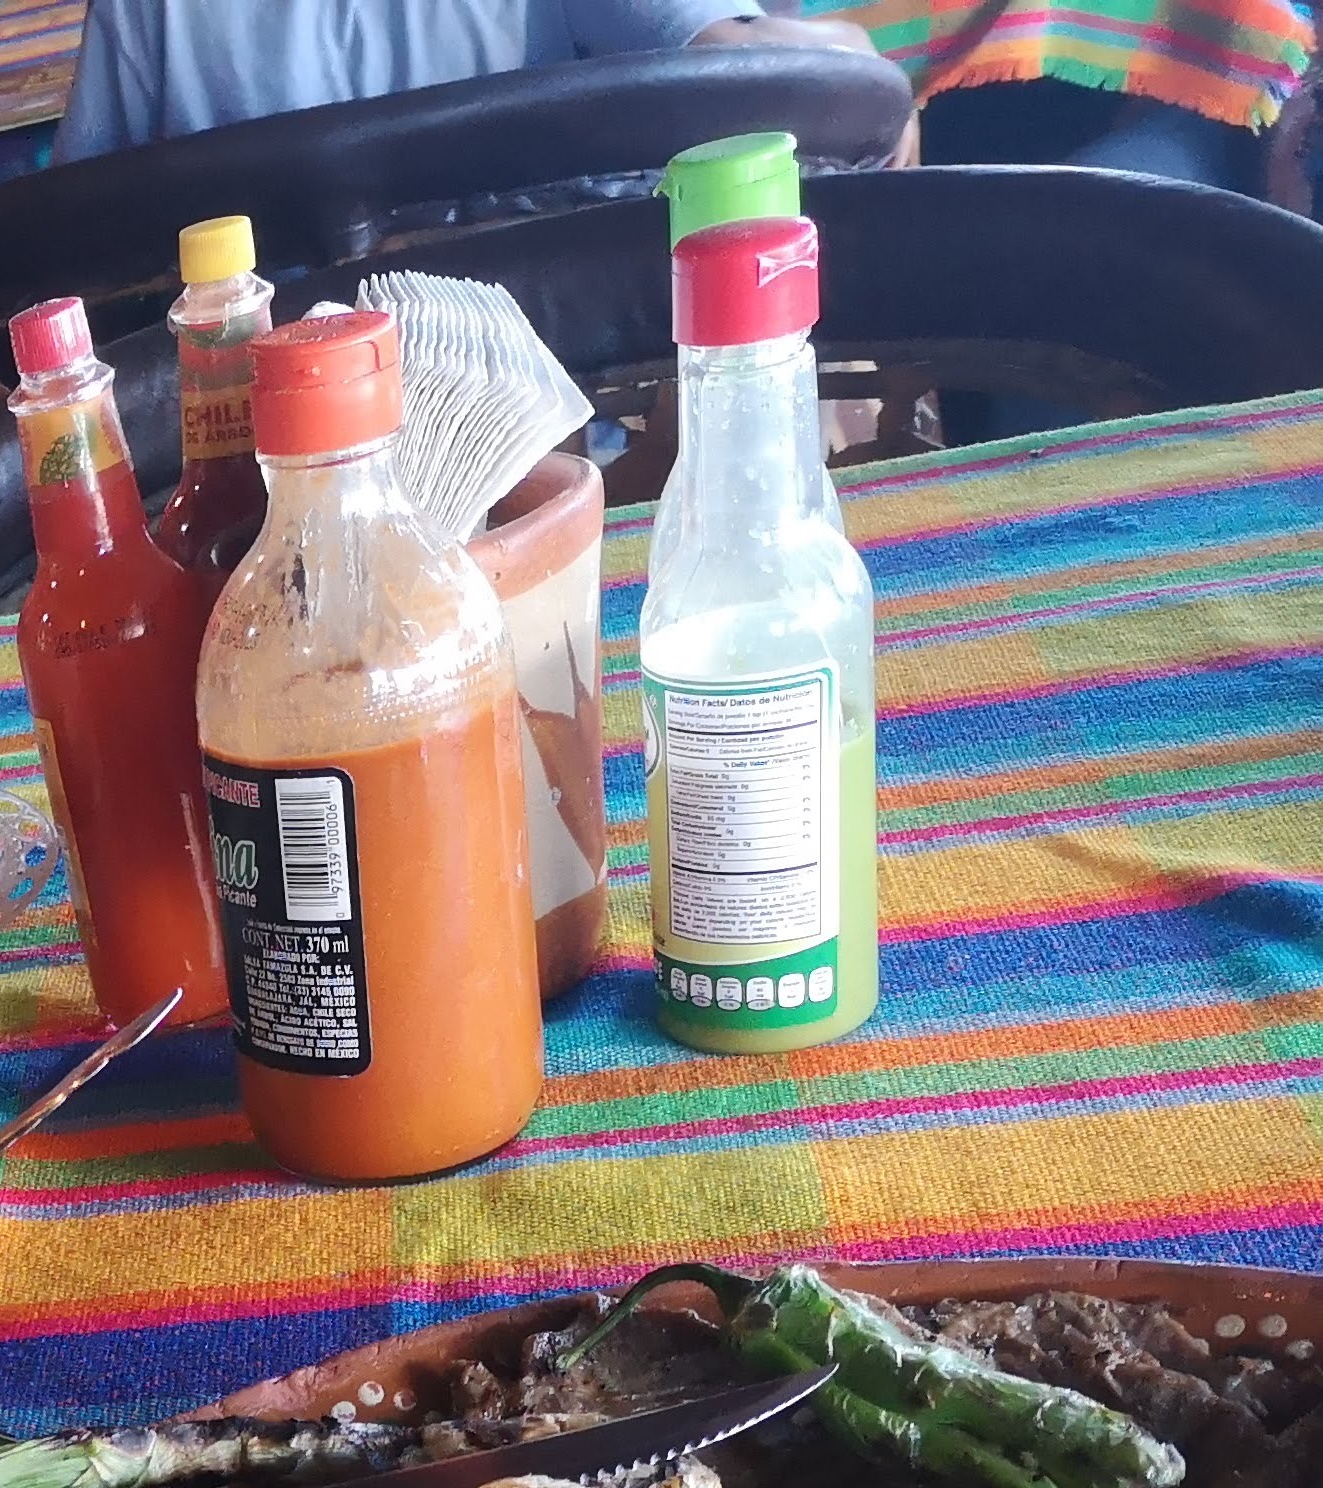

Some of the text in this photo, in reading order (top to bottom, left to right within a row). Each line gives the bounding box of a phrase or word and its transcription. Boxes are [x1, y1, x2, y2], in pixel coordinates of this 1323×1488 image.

[758, 696, 771, 705] de
[326, 804, 340, 846] 00006
[329, 852, 344, 894] 97339
[305, 935, 330, 954] 370
[332, 934, 350, 954] ml
[320, 964, 332, 976] DE
[334, 963, 354, 976] C.V.
